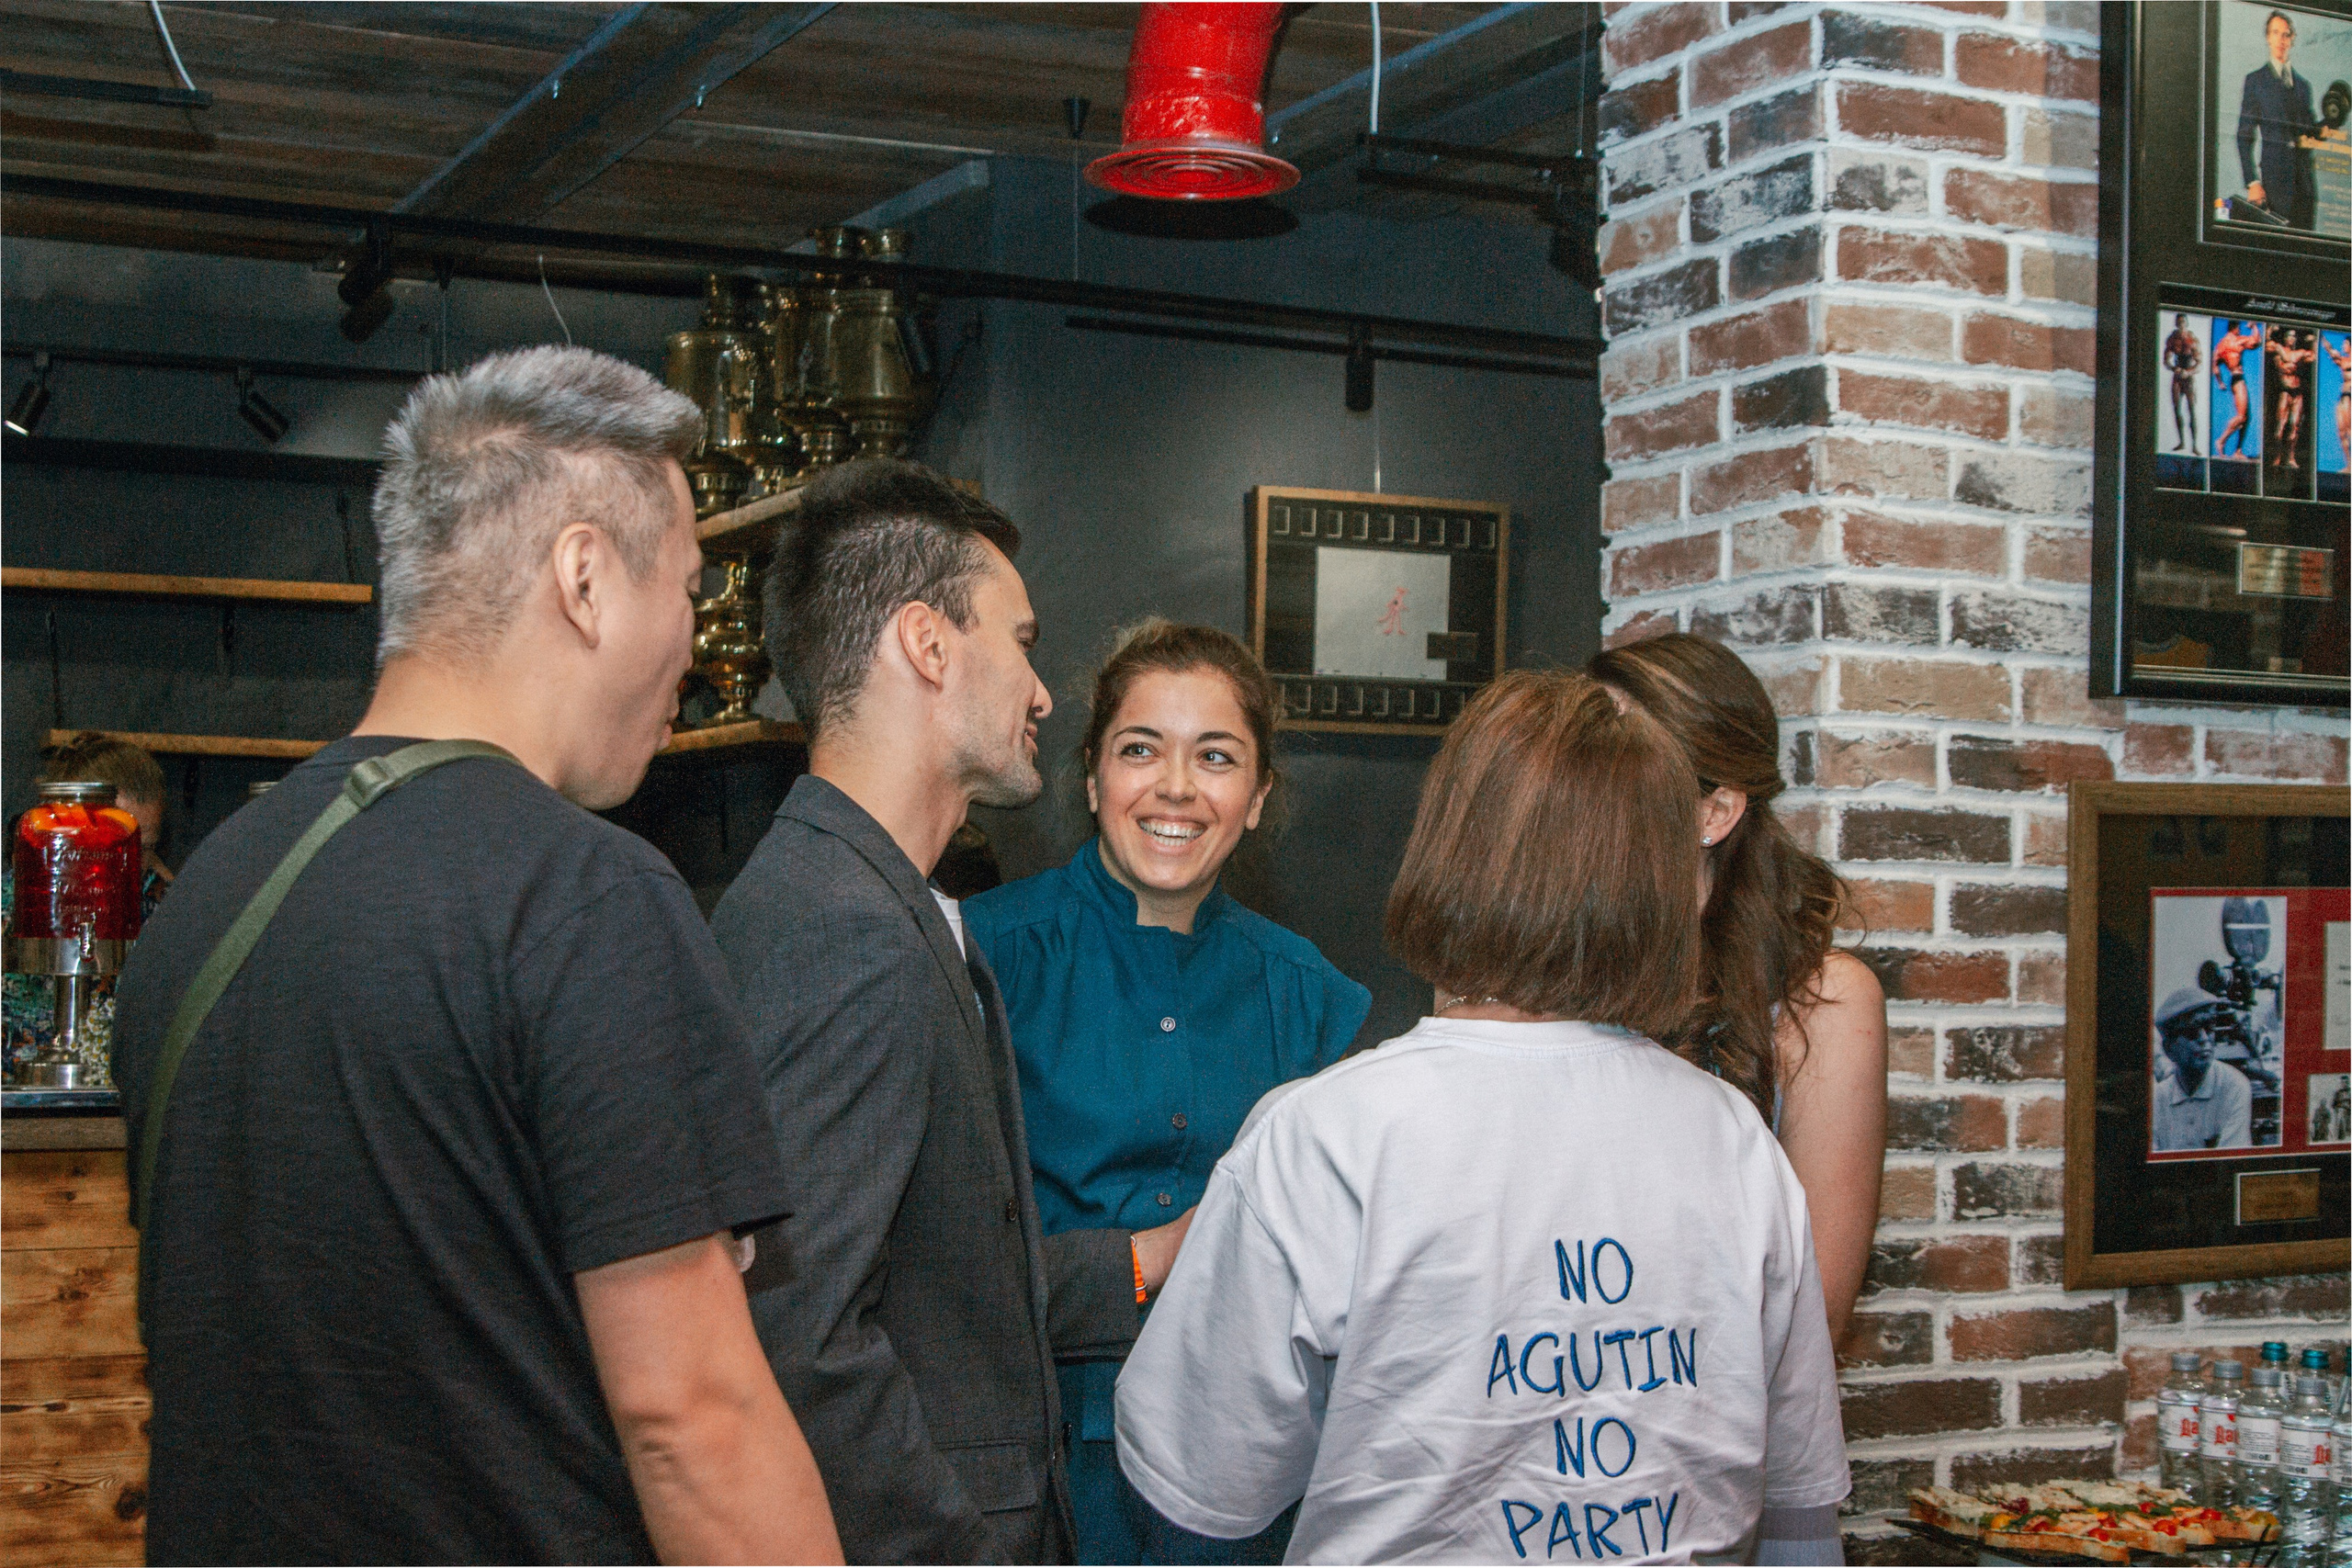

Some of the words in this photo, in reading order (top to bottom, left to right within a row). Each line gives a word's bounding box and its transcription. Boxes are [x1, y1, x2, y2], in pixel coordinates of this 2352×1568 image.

[1555, 1237, 1634, 1304] NO
[1487, 1325, 1698, 1398] AGUTIN
[1553, 1416, 1636, 1479] NO
[1500, 1492, 1679, 1561] PARTY
